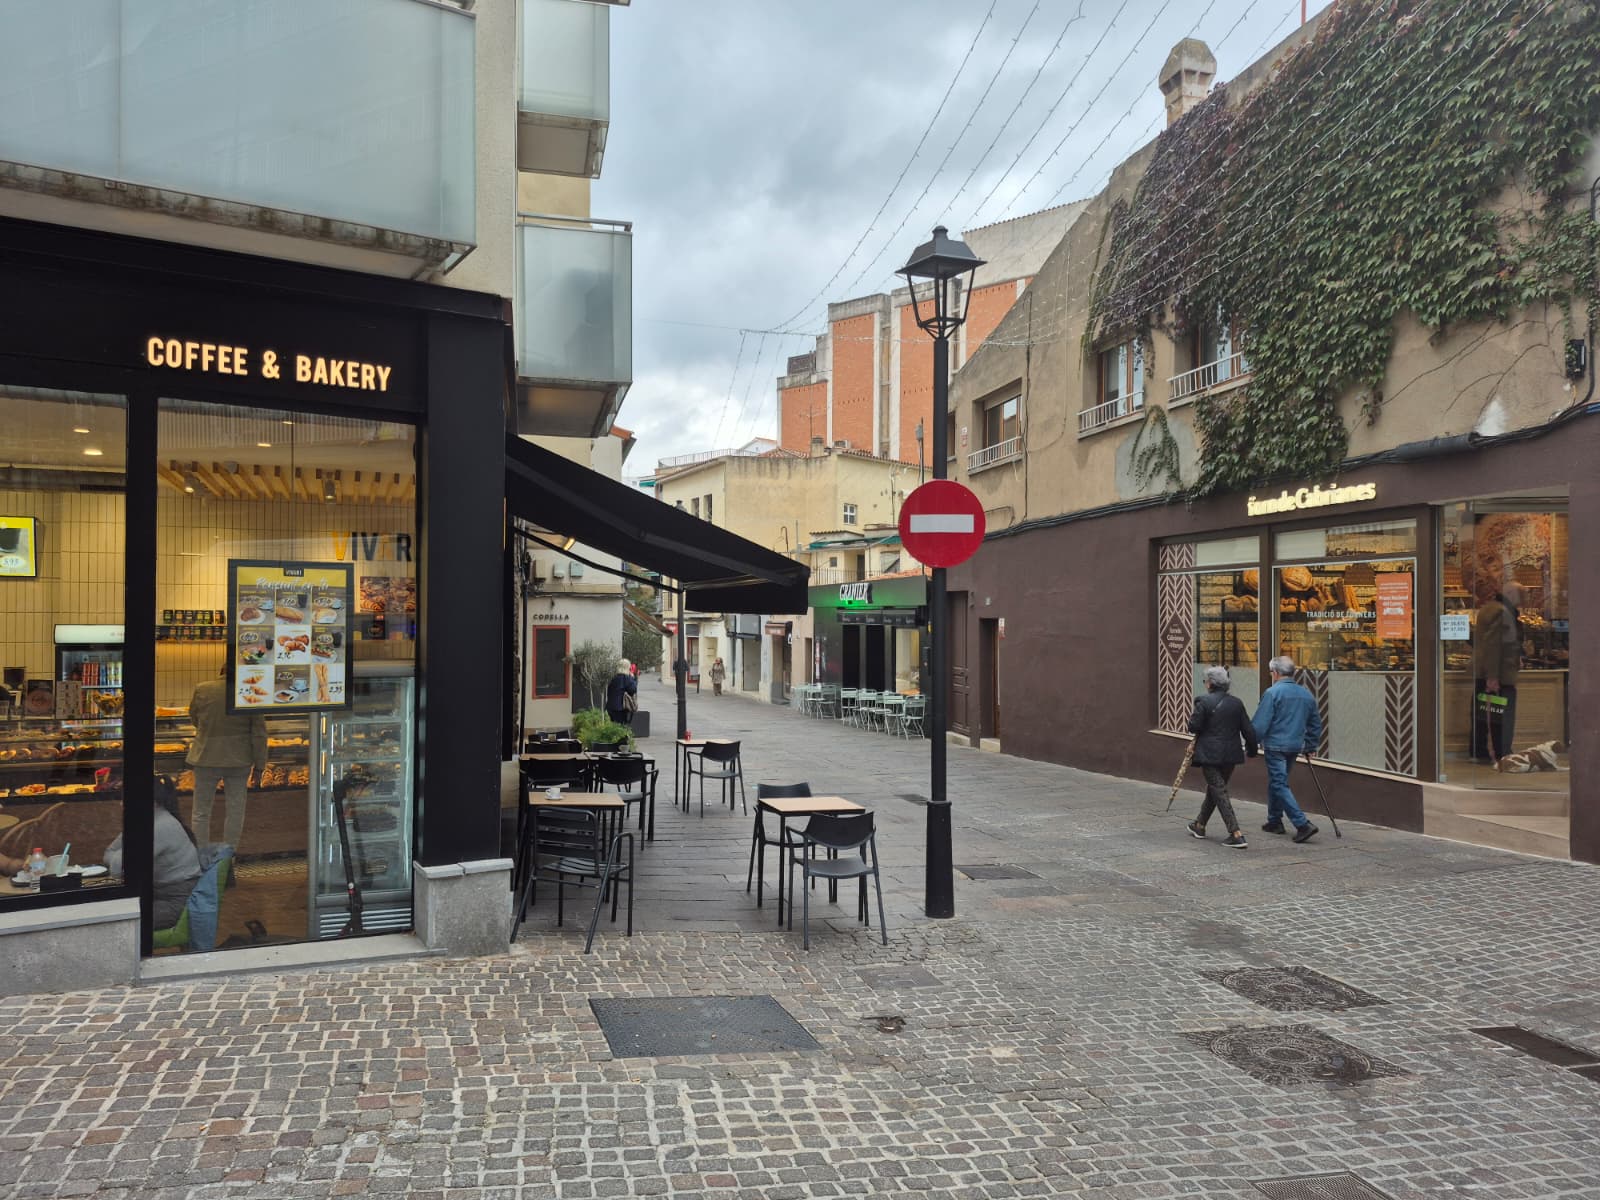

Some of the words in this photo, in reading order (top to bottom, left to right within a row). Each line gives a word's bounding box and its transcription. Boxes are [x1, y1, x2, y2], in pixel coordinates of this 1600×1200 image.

[147, 337, 249, 376] COFFEE
[261, 350, 280, 380] &
[295, 354, 392, 392] BAKERY
[1306, 609, 1334, 619] TRADICIÓ
